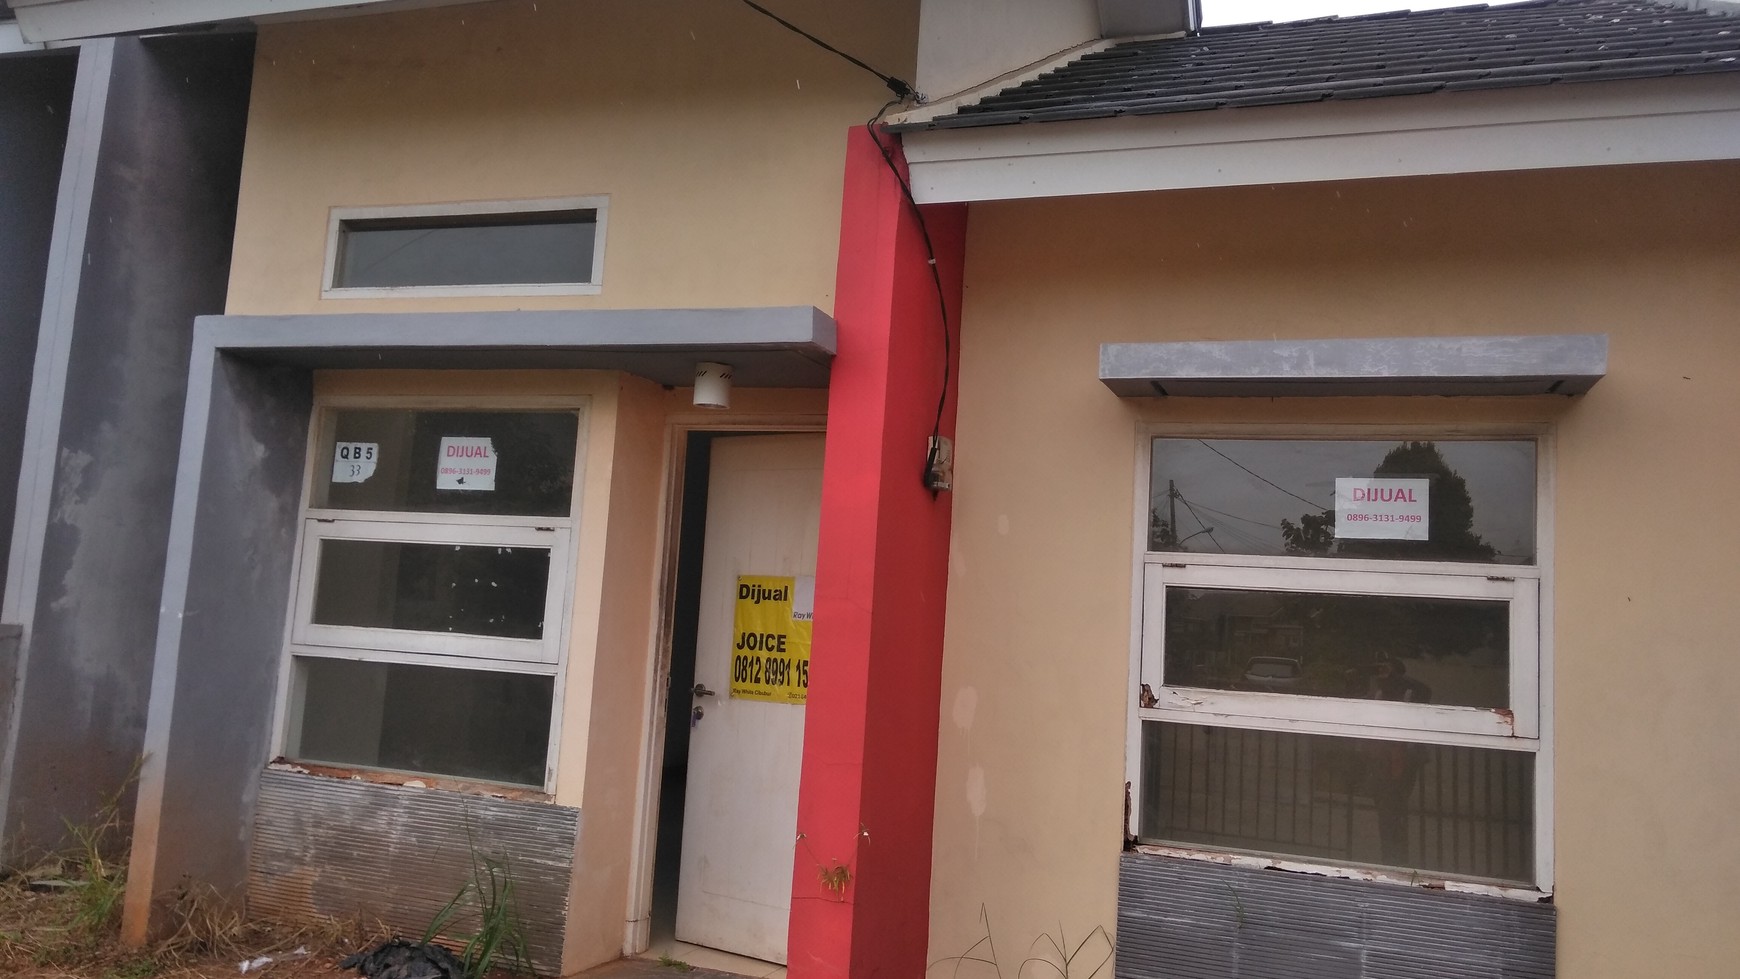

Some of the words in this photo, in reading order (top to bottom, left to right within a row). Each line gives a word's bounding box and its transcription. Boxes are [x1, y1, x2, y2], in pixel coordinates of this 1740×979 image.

[447, 445, 489, 458] DIJUAL
[440, 467, 491, 476] 0896-3131-9499
[1353, 487, 1417, 503] DIJUAL
[1346, 513, 1422, 523] 0896-3131-9499
[738, 583, 789, 605] Dijual
[736, 632, 787, 653] JOICE
[734, 654, 761, 684] 0812
[764, 656, 791, 687] 8991
